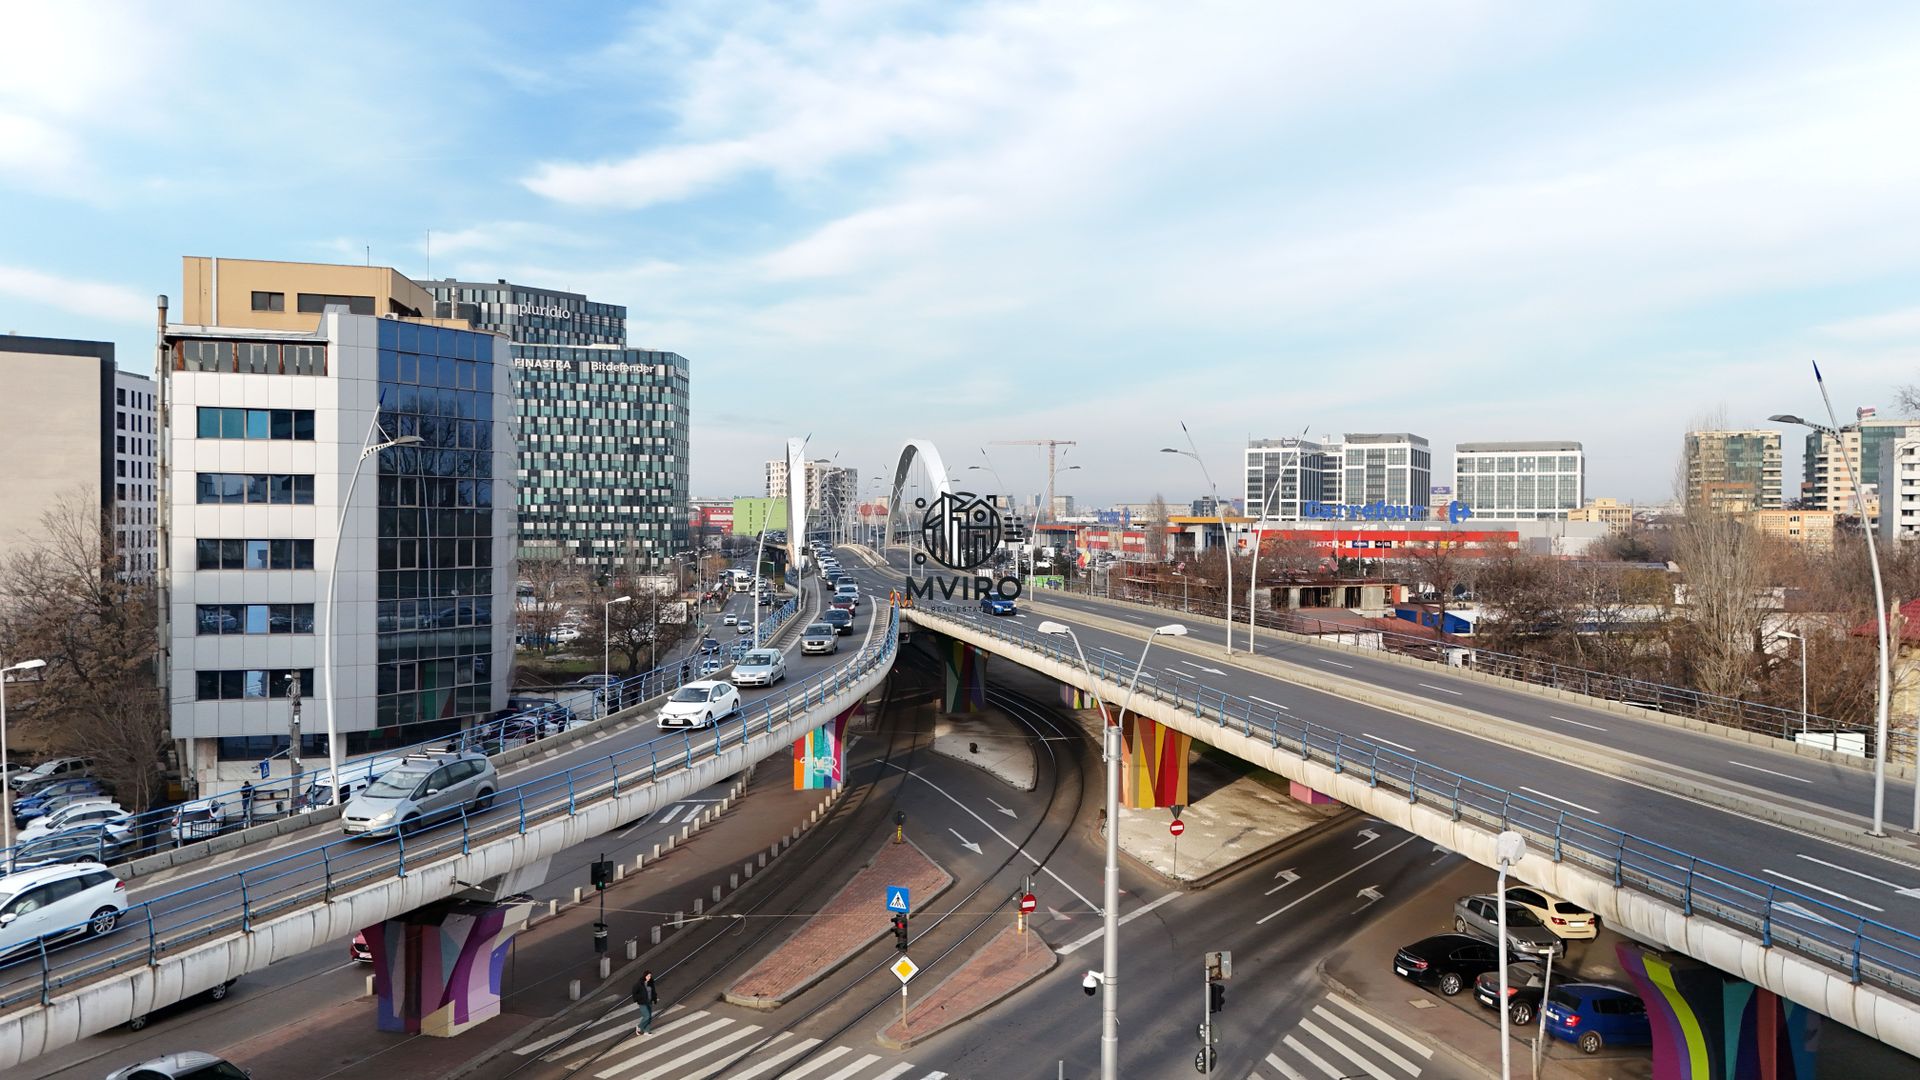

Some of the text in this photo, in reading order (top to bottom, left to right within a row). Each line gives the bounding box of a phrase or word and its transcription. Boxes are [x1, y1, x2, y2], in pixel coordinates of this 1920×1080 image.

[519, 302, 570, 319] pluridio
[514, 358, 571, 371] FINASTRA
[591, 361, 655, 374] Bitdefender
[1305, 500, 1425, 519] Carrefour
